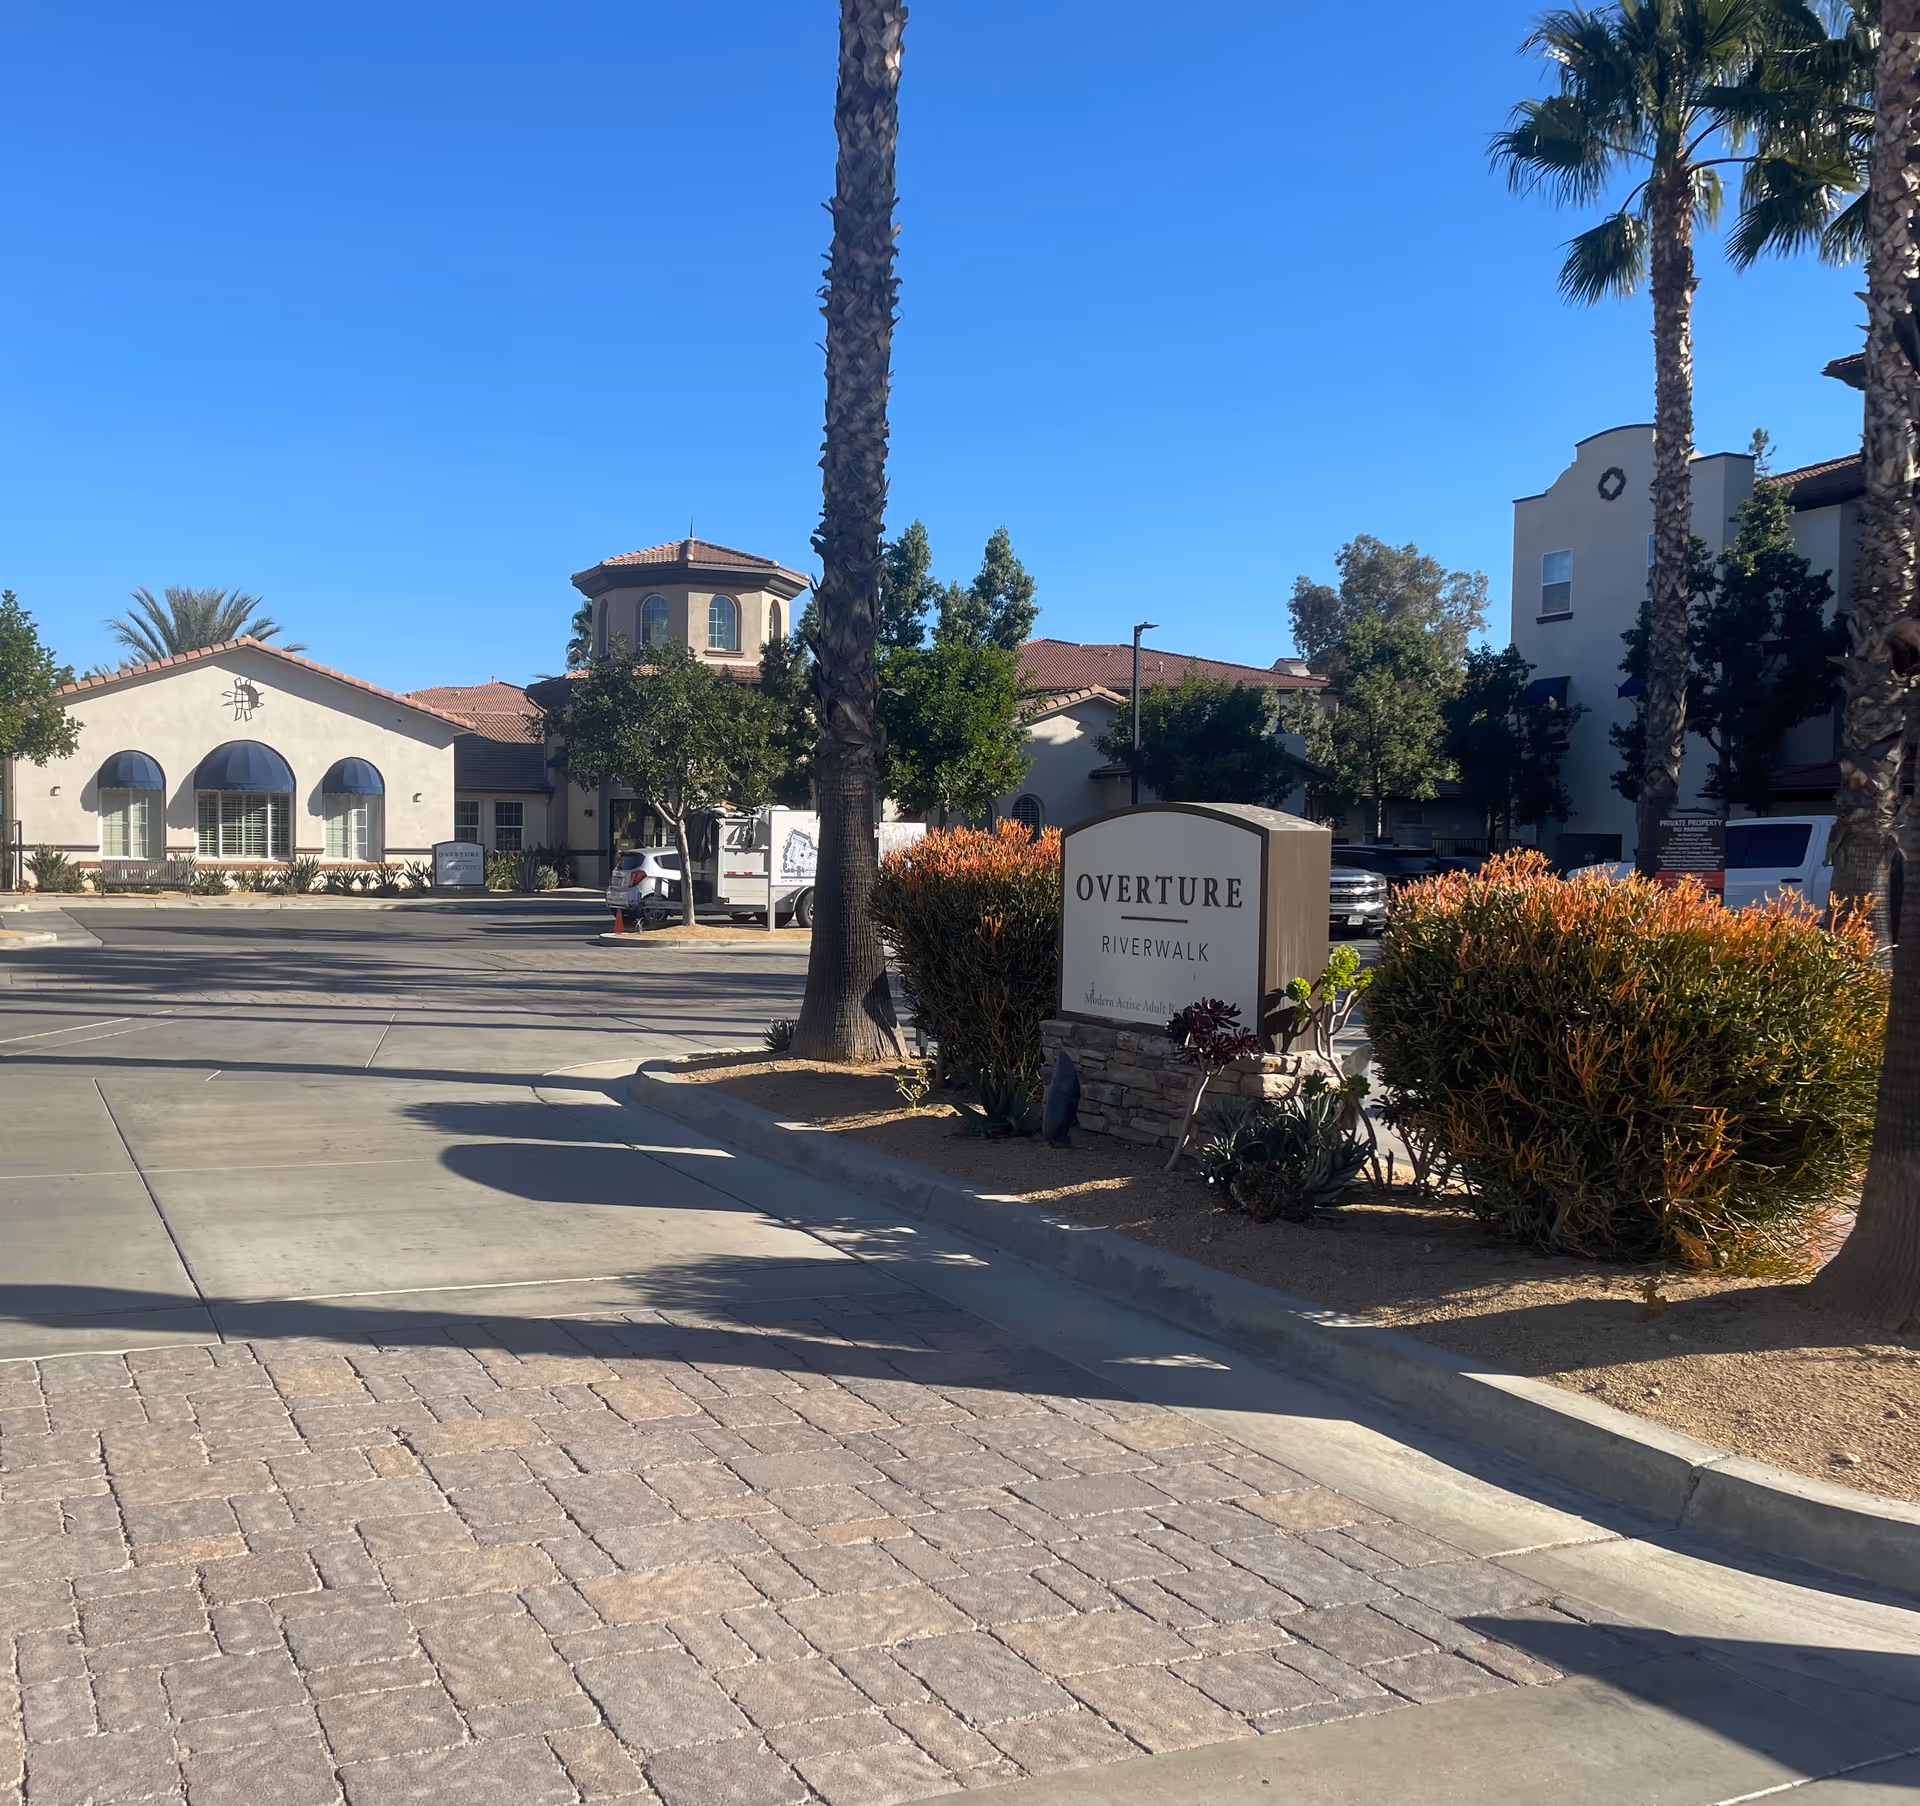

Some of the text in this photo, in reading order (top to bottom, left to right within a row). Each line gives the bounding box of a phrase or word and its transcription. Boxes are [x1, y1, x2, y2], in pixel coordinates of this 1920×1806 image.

[1076, 873, 1243, 909] OVERTURE
[1102, 935, 1209, 962] RIVERWALK
[1084, 992, 1114, 1008] Modern
[1116, 996, 1141, 1011] Active
[1142, 999, 1166, 1015] Adult
